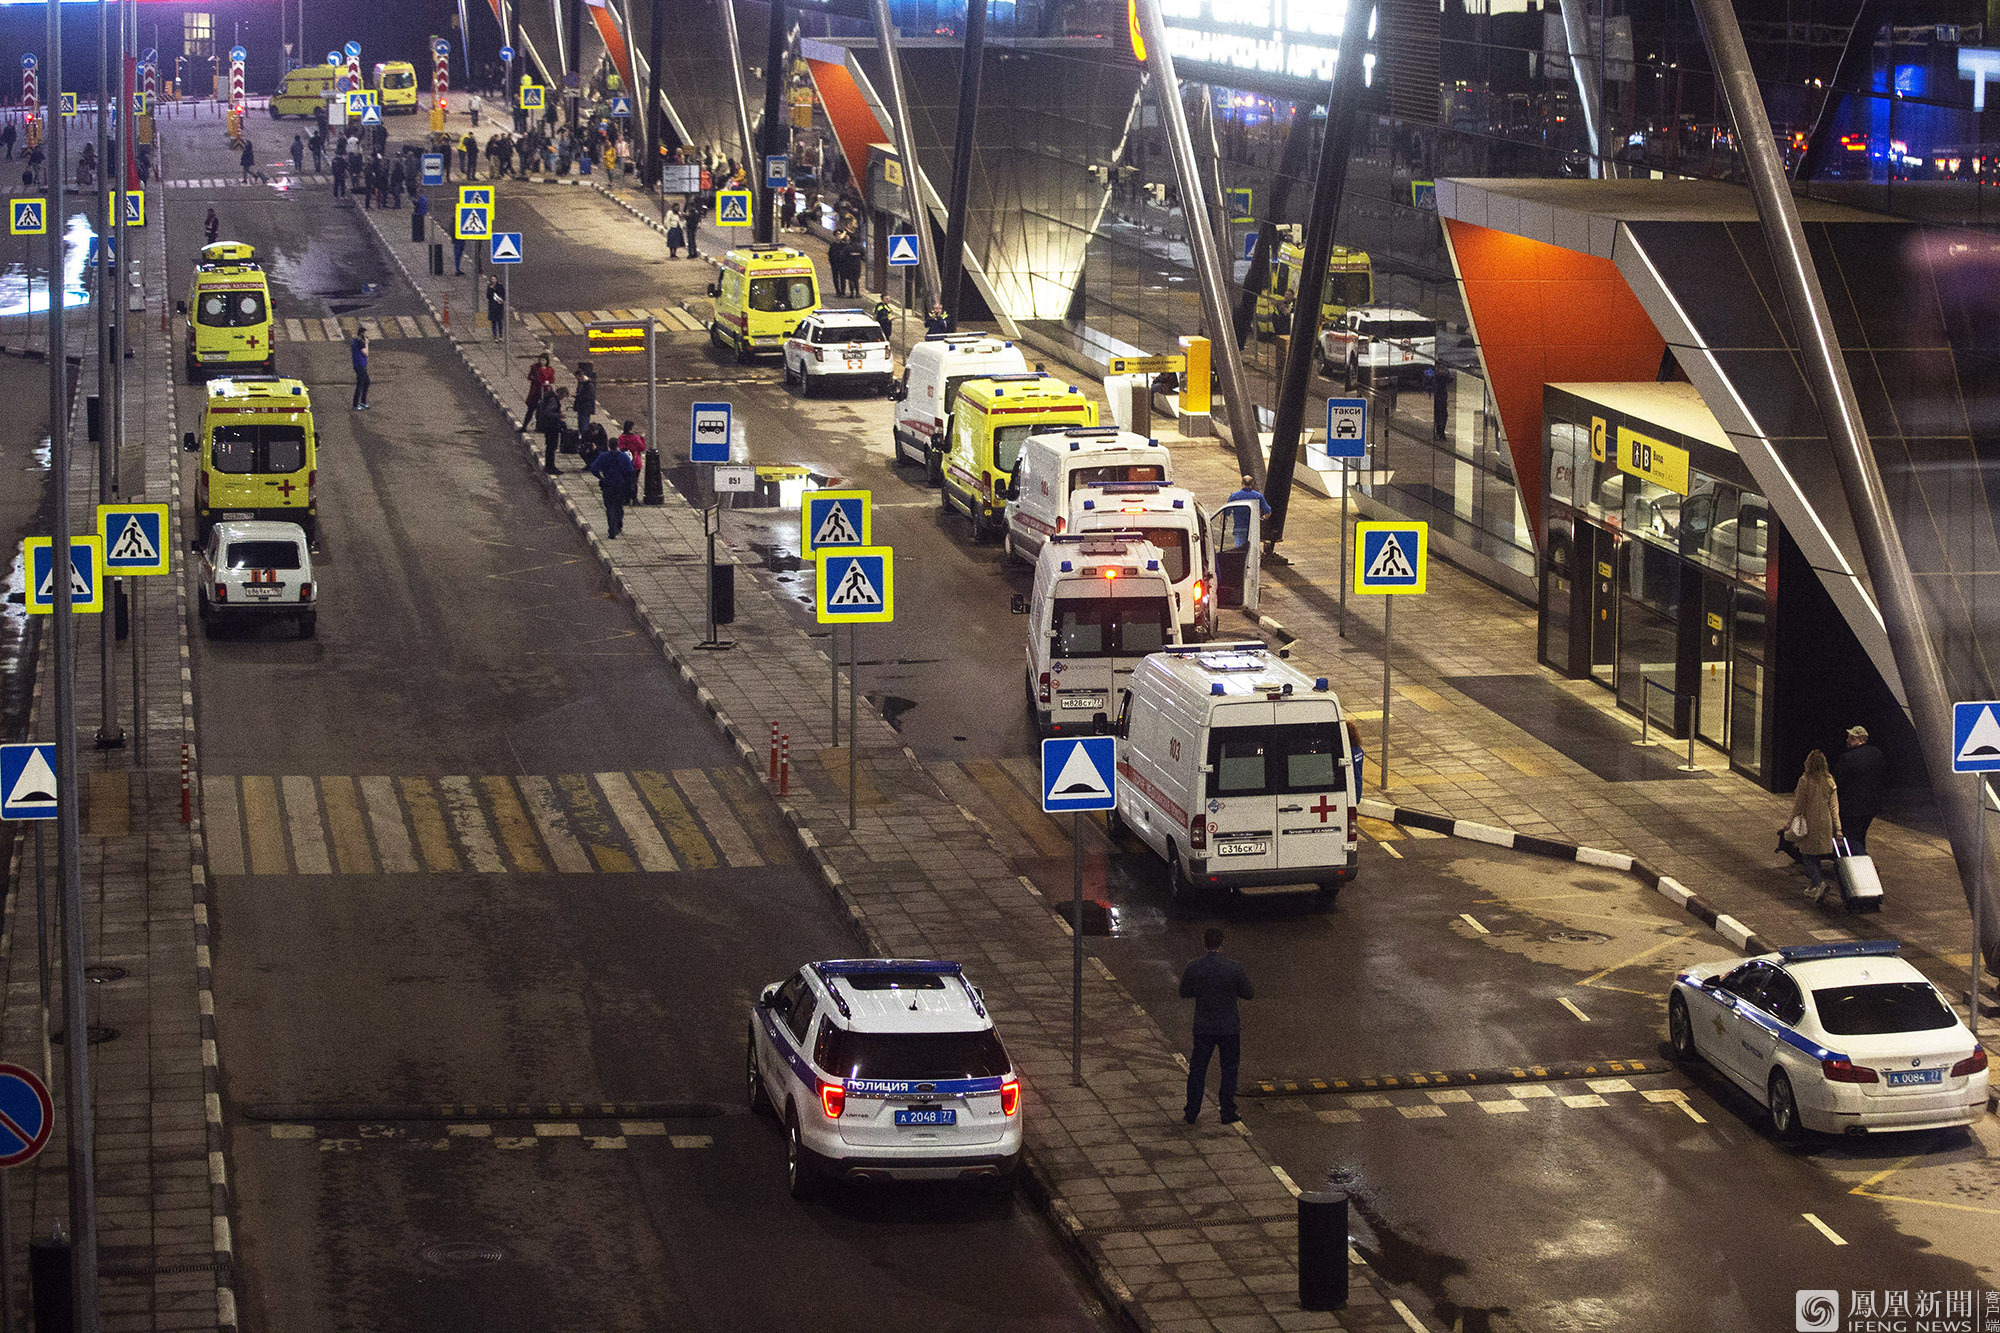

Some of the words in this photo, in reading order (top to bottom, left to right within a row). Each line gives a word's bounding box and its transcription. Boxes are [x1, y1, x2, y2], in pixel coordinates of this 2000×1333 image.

[1593, 424, 1602, 456] C
[1222, 844, 1253, 854] С316СК
[1901, 1073, 1925, 1083] 0084
[847, 1081, 909, 1092] ПОЛИЦИЯ
[901, 1114, 907, 1122] А
[911, 1111, 936, 1122] 2048
[942, 1110, 952, 1119] 77
